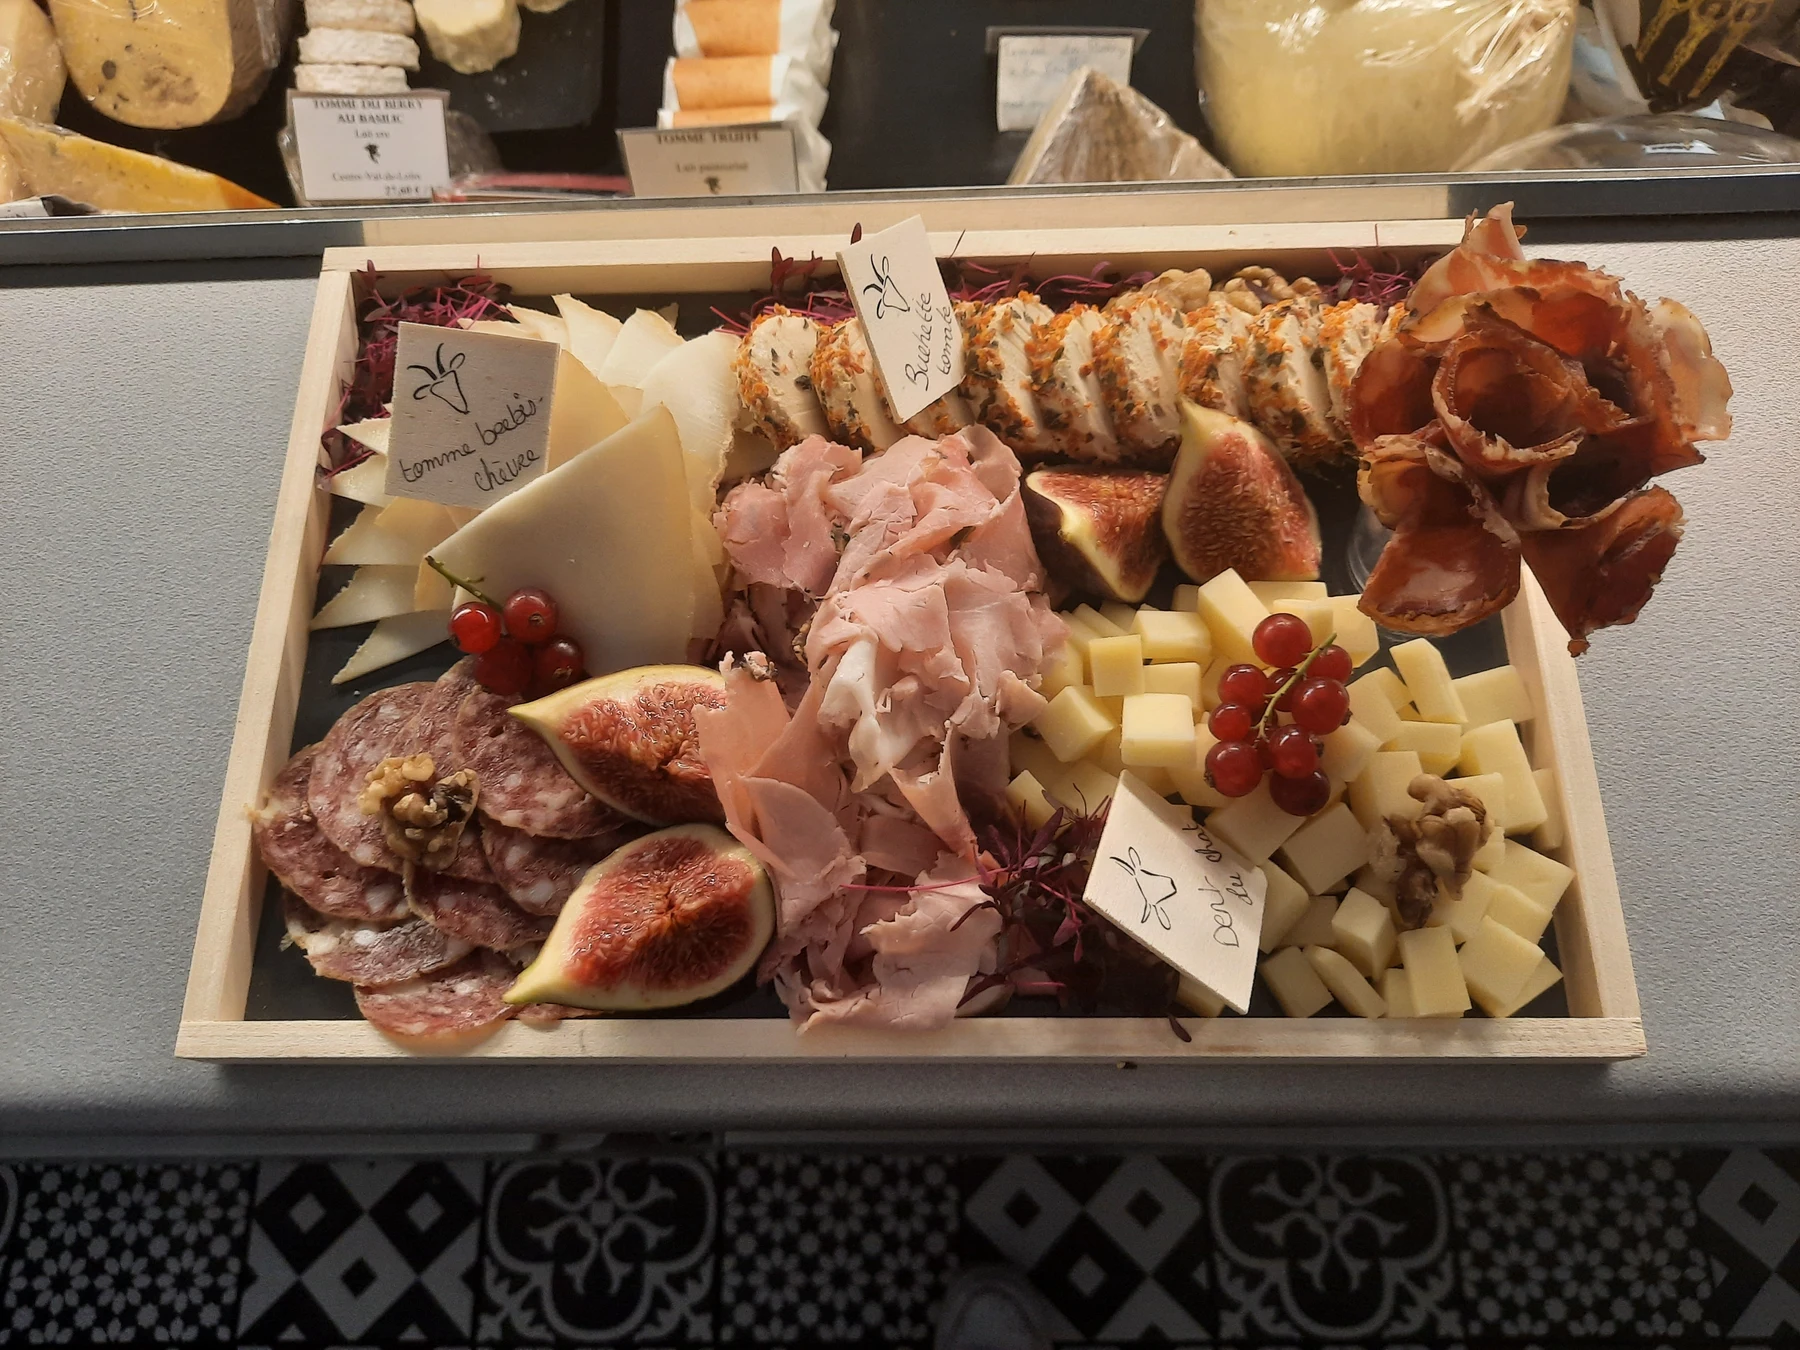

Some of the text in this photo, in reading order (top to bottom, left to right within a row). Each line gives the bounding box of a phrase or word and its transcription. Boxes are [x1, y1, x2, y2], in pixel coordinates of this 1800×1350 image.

[313, 99, 424, 109] TOMME DU BERRY
[338, 113, 356, 123] AU
[656, 133, 704, 145] TOMME
[399, 443, 476, 483] tomme
[1181, 823, 1222, 862] chat
[1198, 875, 1240, 948] Dent
